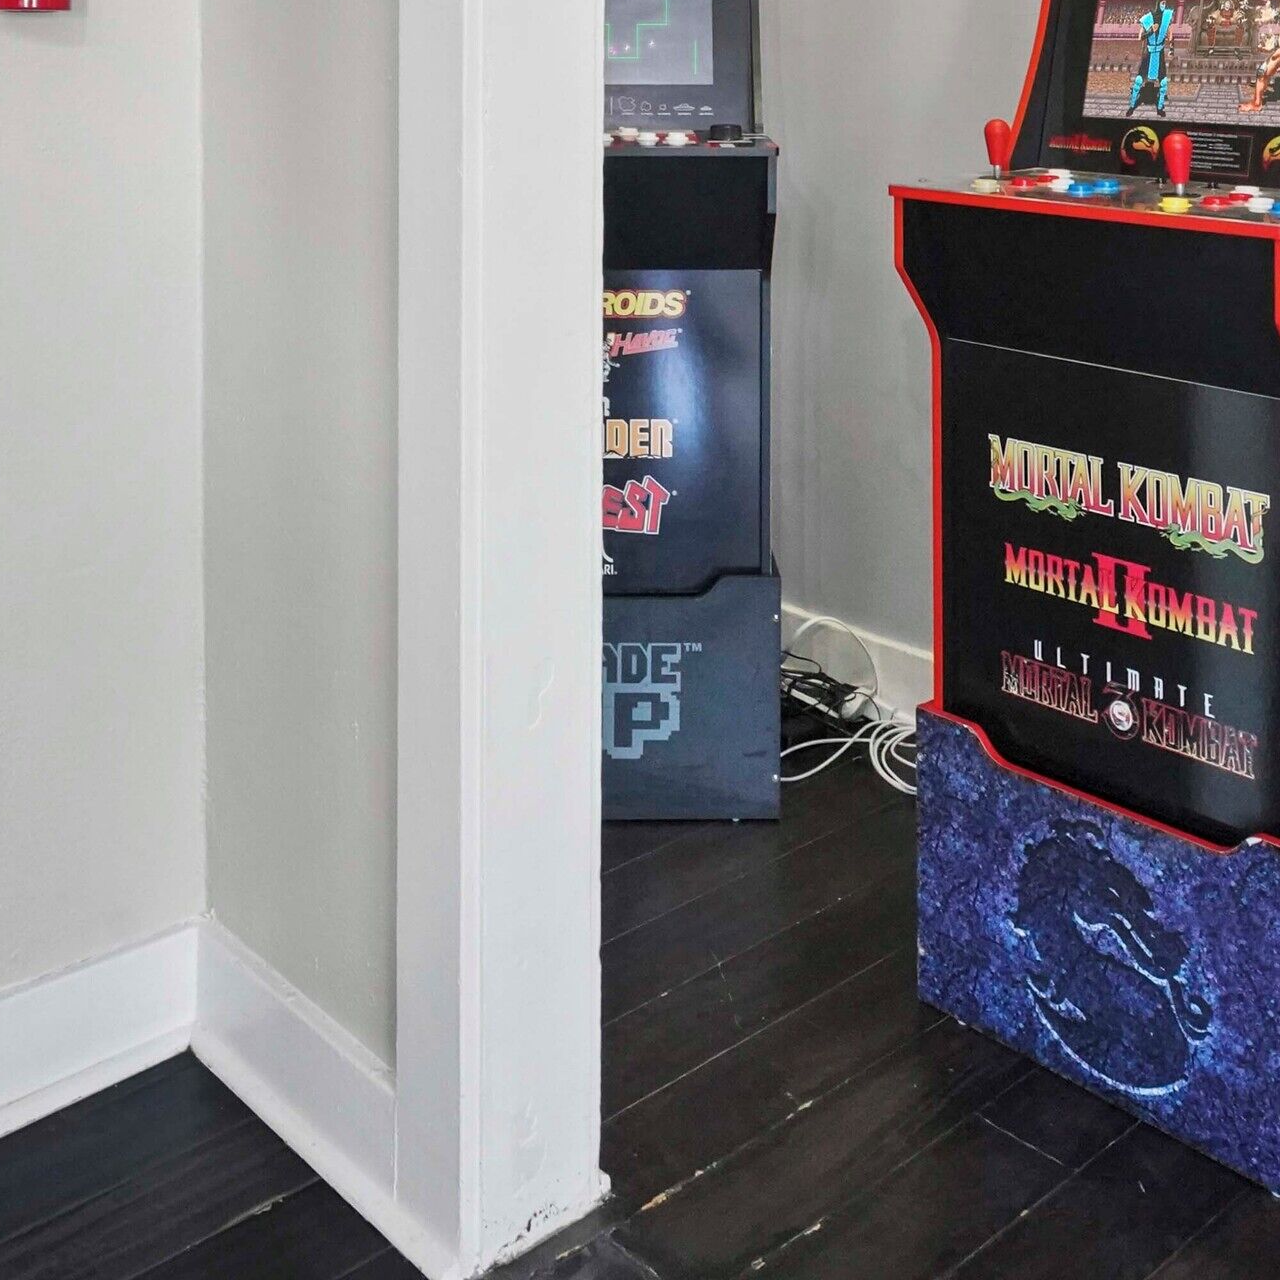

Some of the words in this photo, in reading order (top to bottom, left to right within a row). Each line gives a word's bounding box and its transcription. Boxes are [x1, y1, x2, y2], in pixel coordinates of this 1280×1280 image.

[988, 433, 1114, 517] MORTAL
[1117, 462, 1270, 553] KOMBAT
[1005, 542, 1119, 614] MORTAL
[1124, 575, 1258, 654] KOMBAT
[1001, 650, 1098, 724] MORTAL
[1141, 697, 1258, 779] KOMBAT
[1033, 639, 1216, 718] ULTIMATE
